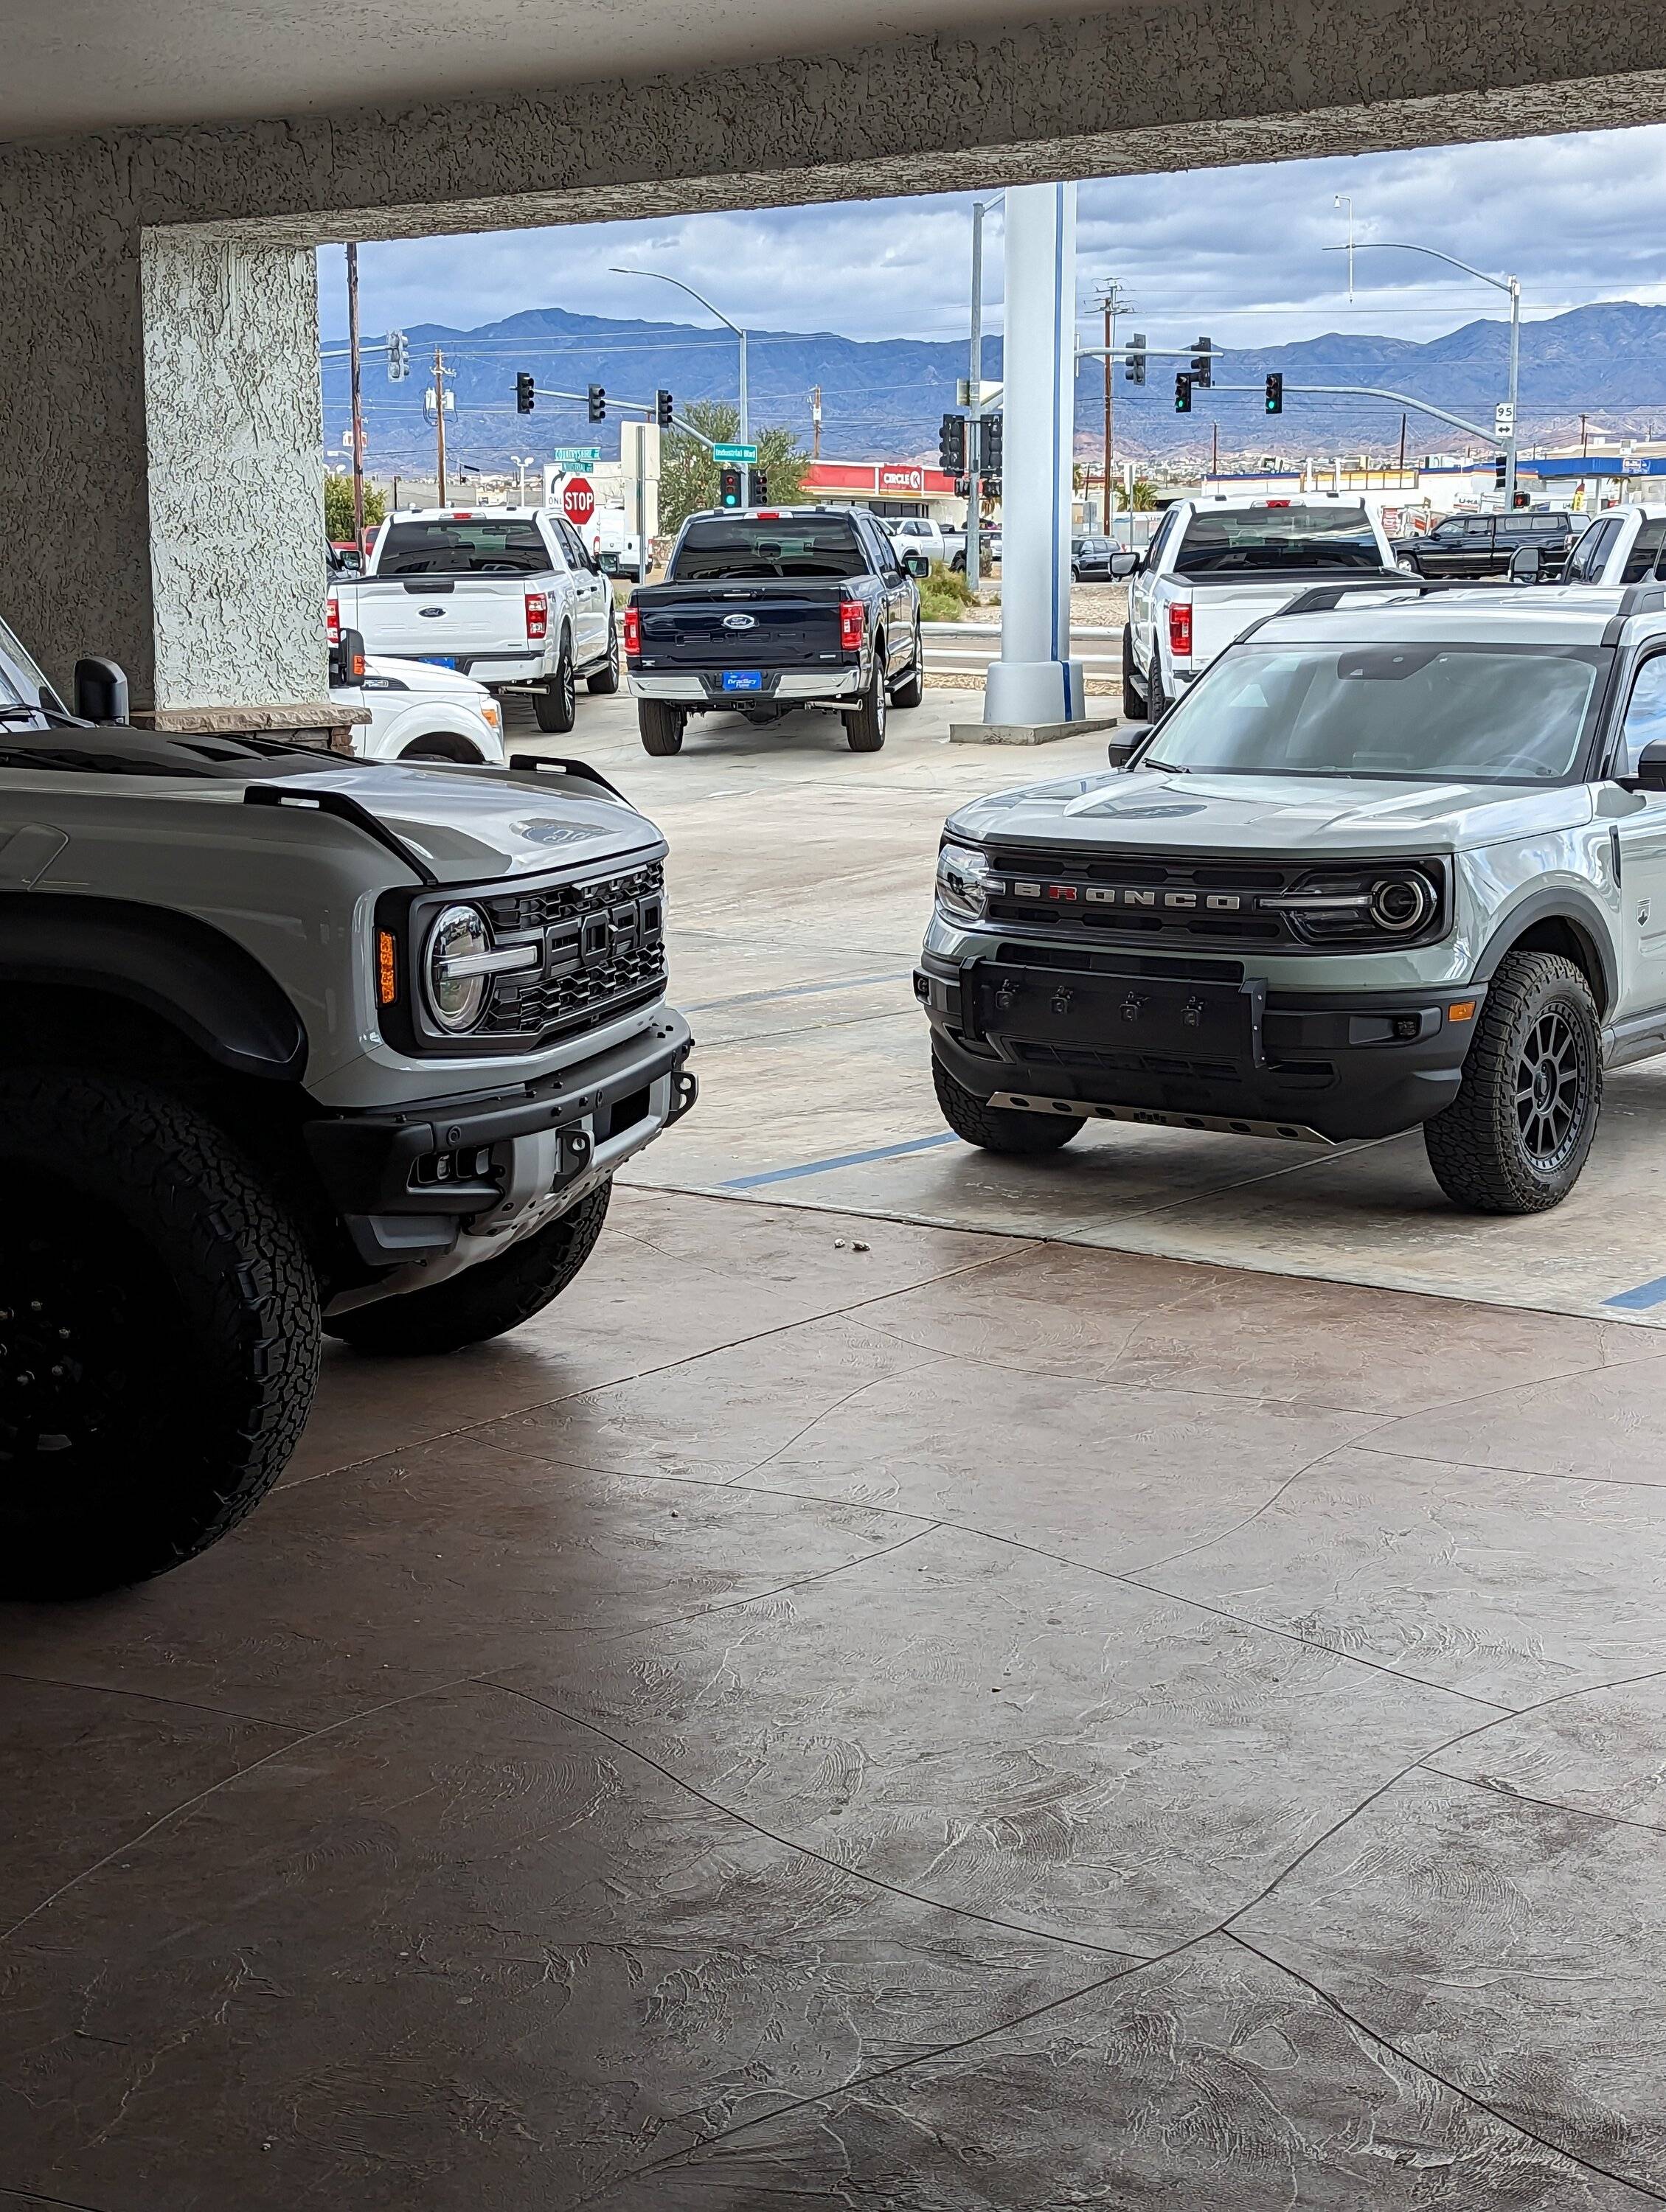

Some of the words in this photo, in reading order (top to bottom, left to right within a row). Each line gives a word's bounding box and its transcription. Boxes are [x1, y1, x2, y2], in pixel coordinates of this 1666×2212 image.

[1498, 408, 1512, 416] 95
[884, 473, 910, 484] CIRCLE
[565, 492, 593, 510] STOP
[1014, 883, 1240, 910] BRONCO
[544, 889, 663, 981] FORD
